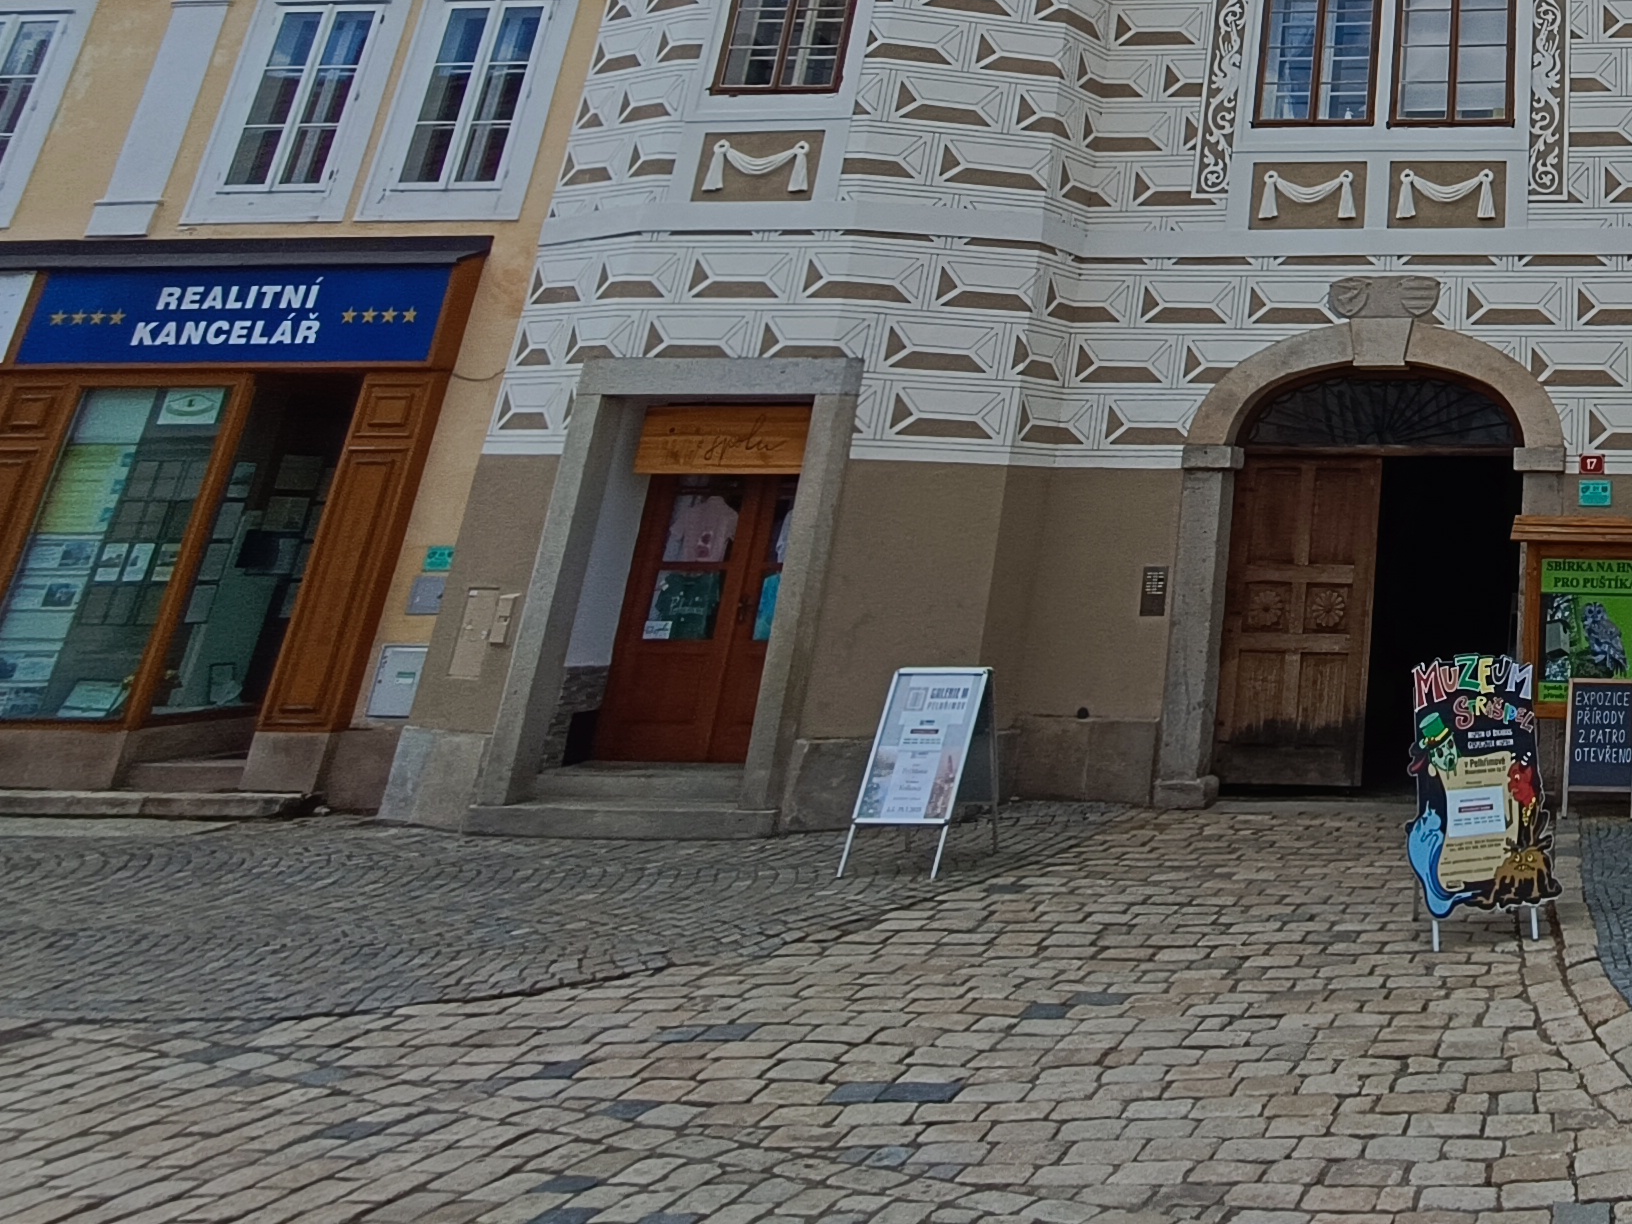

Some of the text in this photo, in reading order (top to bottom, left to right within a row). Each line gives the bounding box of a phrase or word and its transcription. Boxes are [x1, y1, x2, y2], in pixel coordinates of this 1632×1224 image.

[156, 277, 324, 310] REALITNÍ
[130, 313, 321, 345] KANCELÁŘ
[703, 414, 785, 465] spolu
[1586, 458, 1597, 469] 17
[1546, 560, 1594, 573] SBÍRKA
[1596, 562, 1613, 573] NA
[1553, 577, 1580, 588] PRO
[1411, 655, 1533, 712] MUZEUM
[1575, 691, 1631, 706] EXPOZICE
[1453, 695, 1535, 733] STRAŠIDEL
[1576, 707, 1626, 725] PŘÍRODY
[1574, 745, 1632, 763] OTEVŘENO
